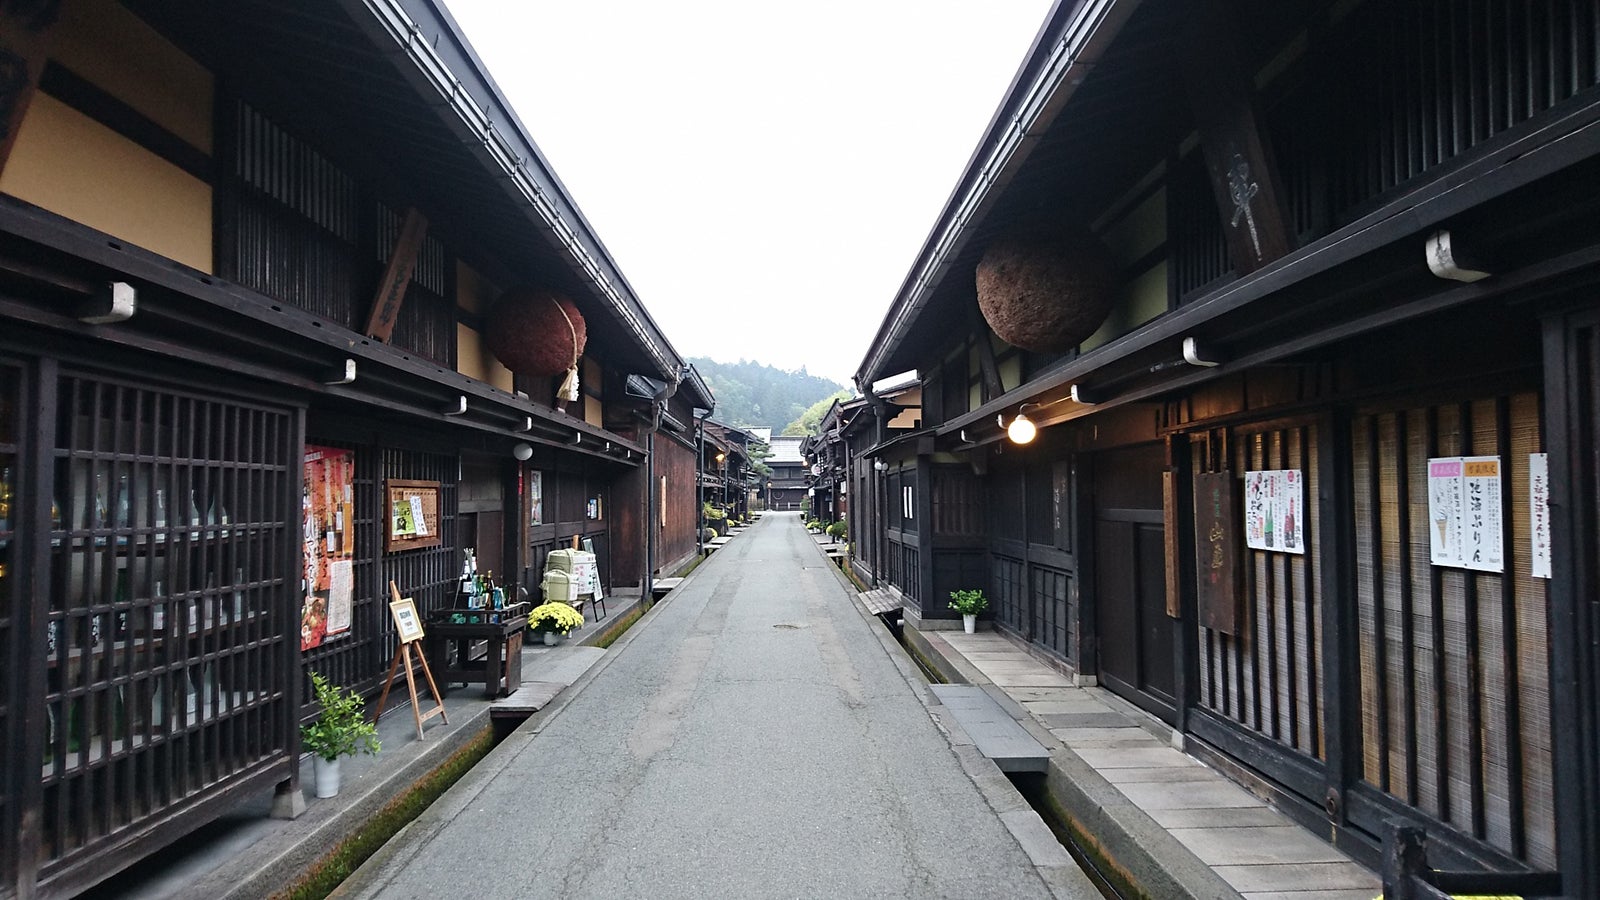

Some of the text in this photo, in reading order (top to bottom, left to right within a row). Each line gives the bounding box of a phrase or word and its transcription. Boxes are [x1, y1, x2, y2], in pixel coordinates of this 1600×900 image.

[1469, 479, 1483, 563] 地酒ぷりん
